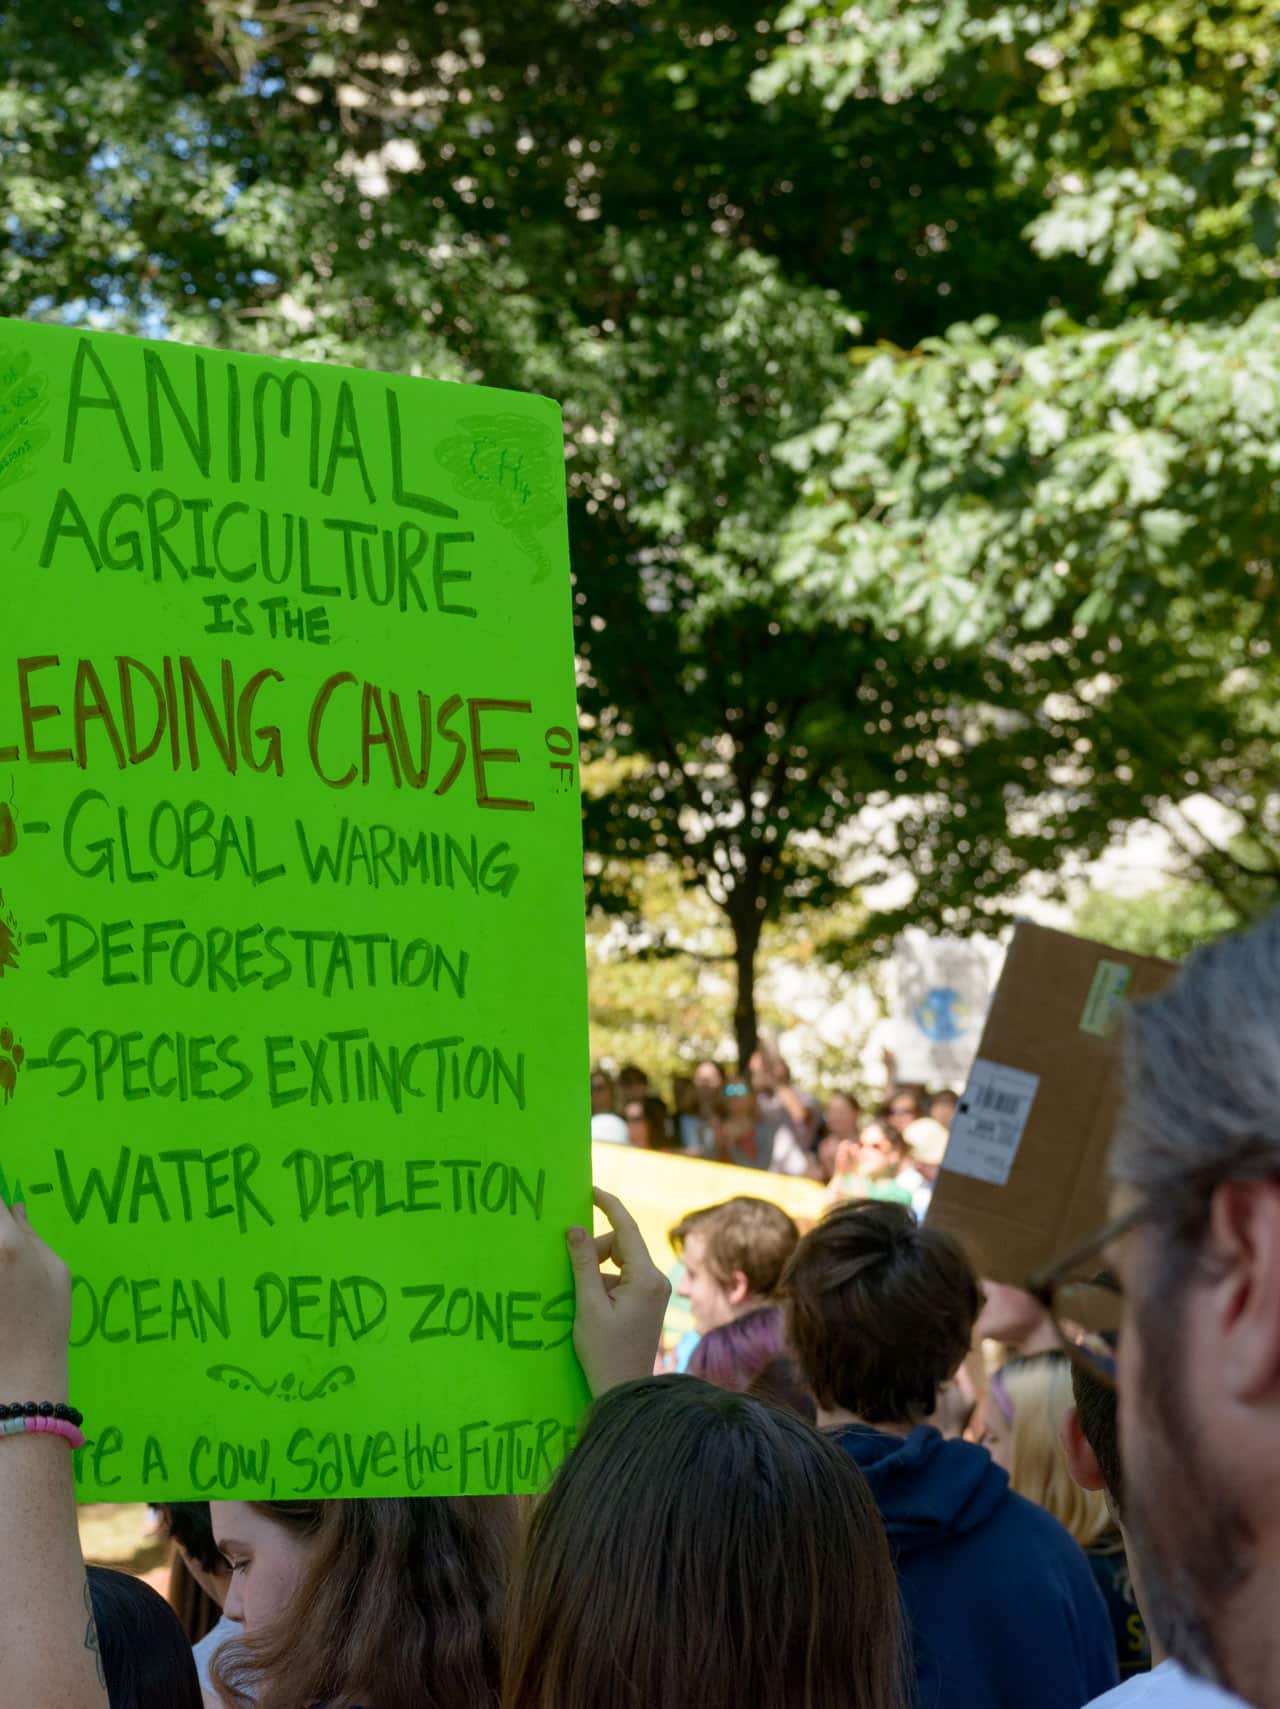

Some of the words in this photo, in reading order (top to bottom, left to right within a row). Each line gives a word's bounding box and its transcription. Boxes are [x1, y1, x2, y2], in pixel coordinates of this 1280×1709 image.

[63, 337, 459, 519] ANIMAL
[38, 487, 478, 618] AGRICULTURE
[203, 595, 255, 636] IS
[262, 598, 331, 645] THE
[307, 671, 535, 812] CAUSE
[295, 817, 521, 898] WARMING
[265, 1028, 526, 1115] EXTINCTION
[282, 1149, 545, 1222] DEPLETION
[69, 1275, 230, 1345] OCEAN
[254, 1271, 387, 1343] DEAD
[400, 1283, 574, 1352] ZONES
[141, 1434, 169, 1484] A
[403, 1422, 454, 1493] the
